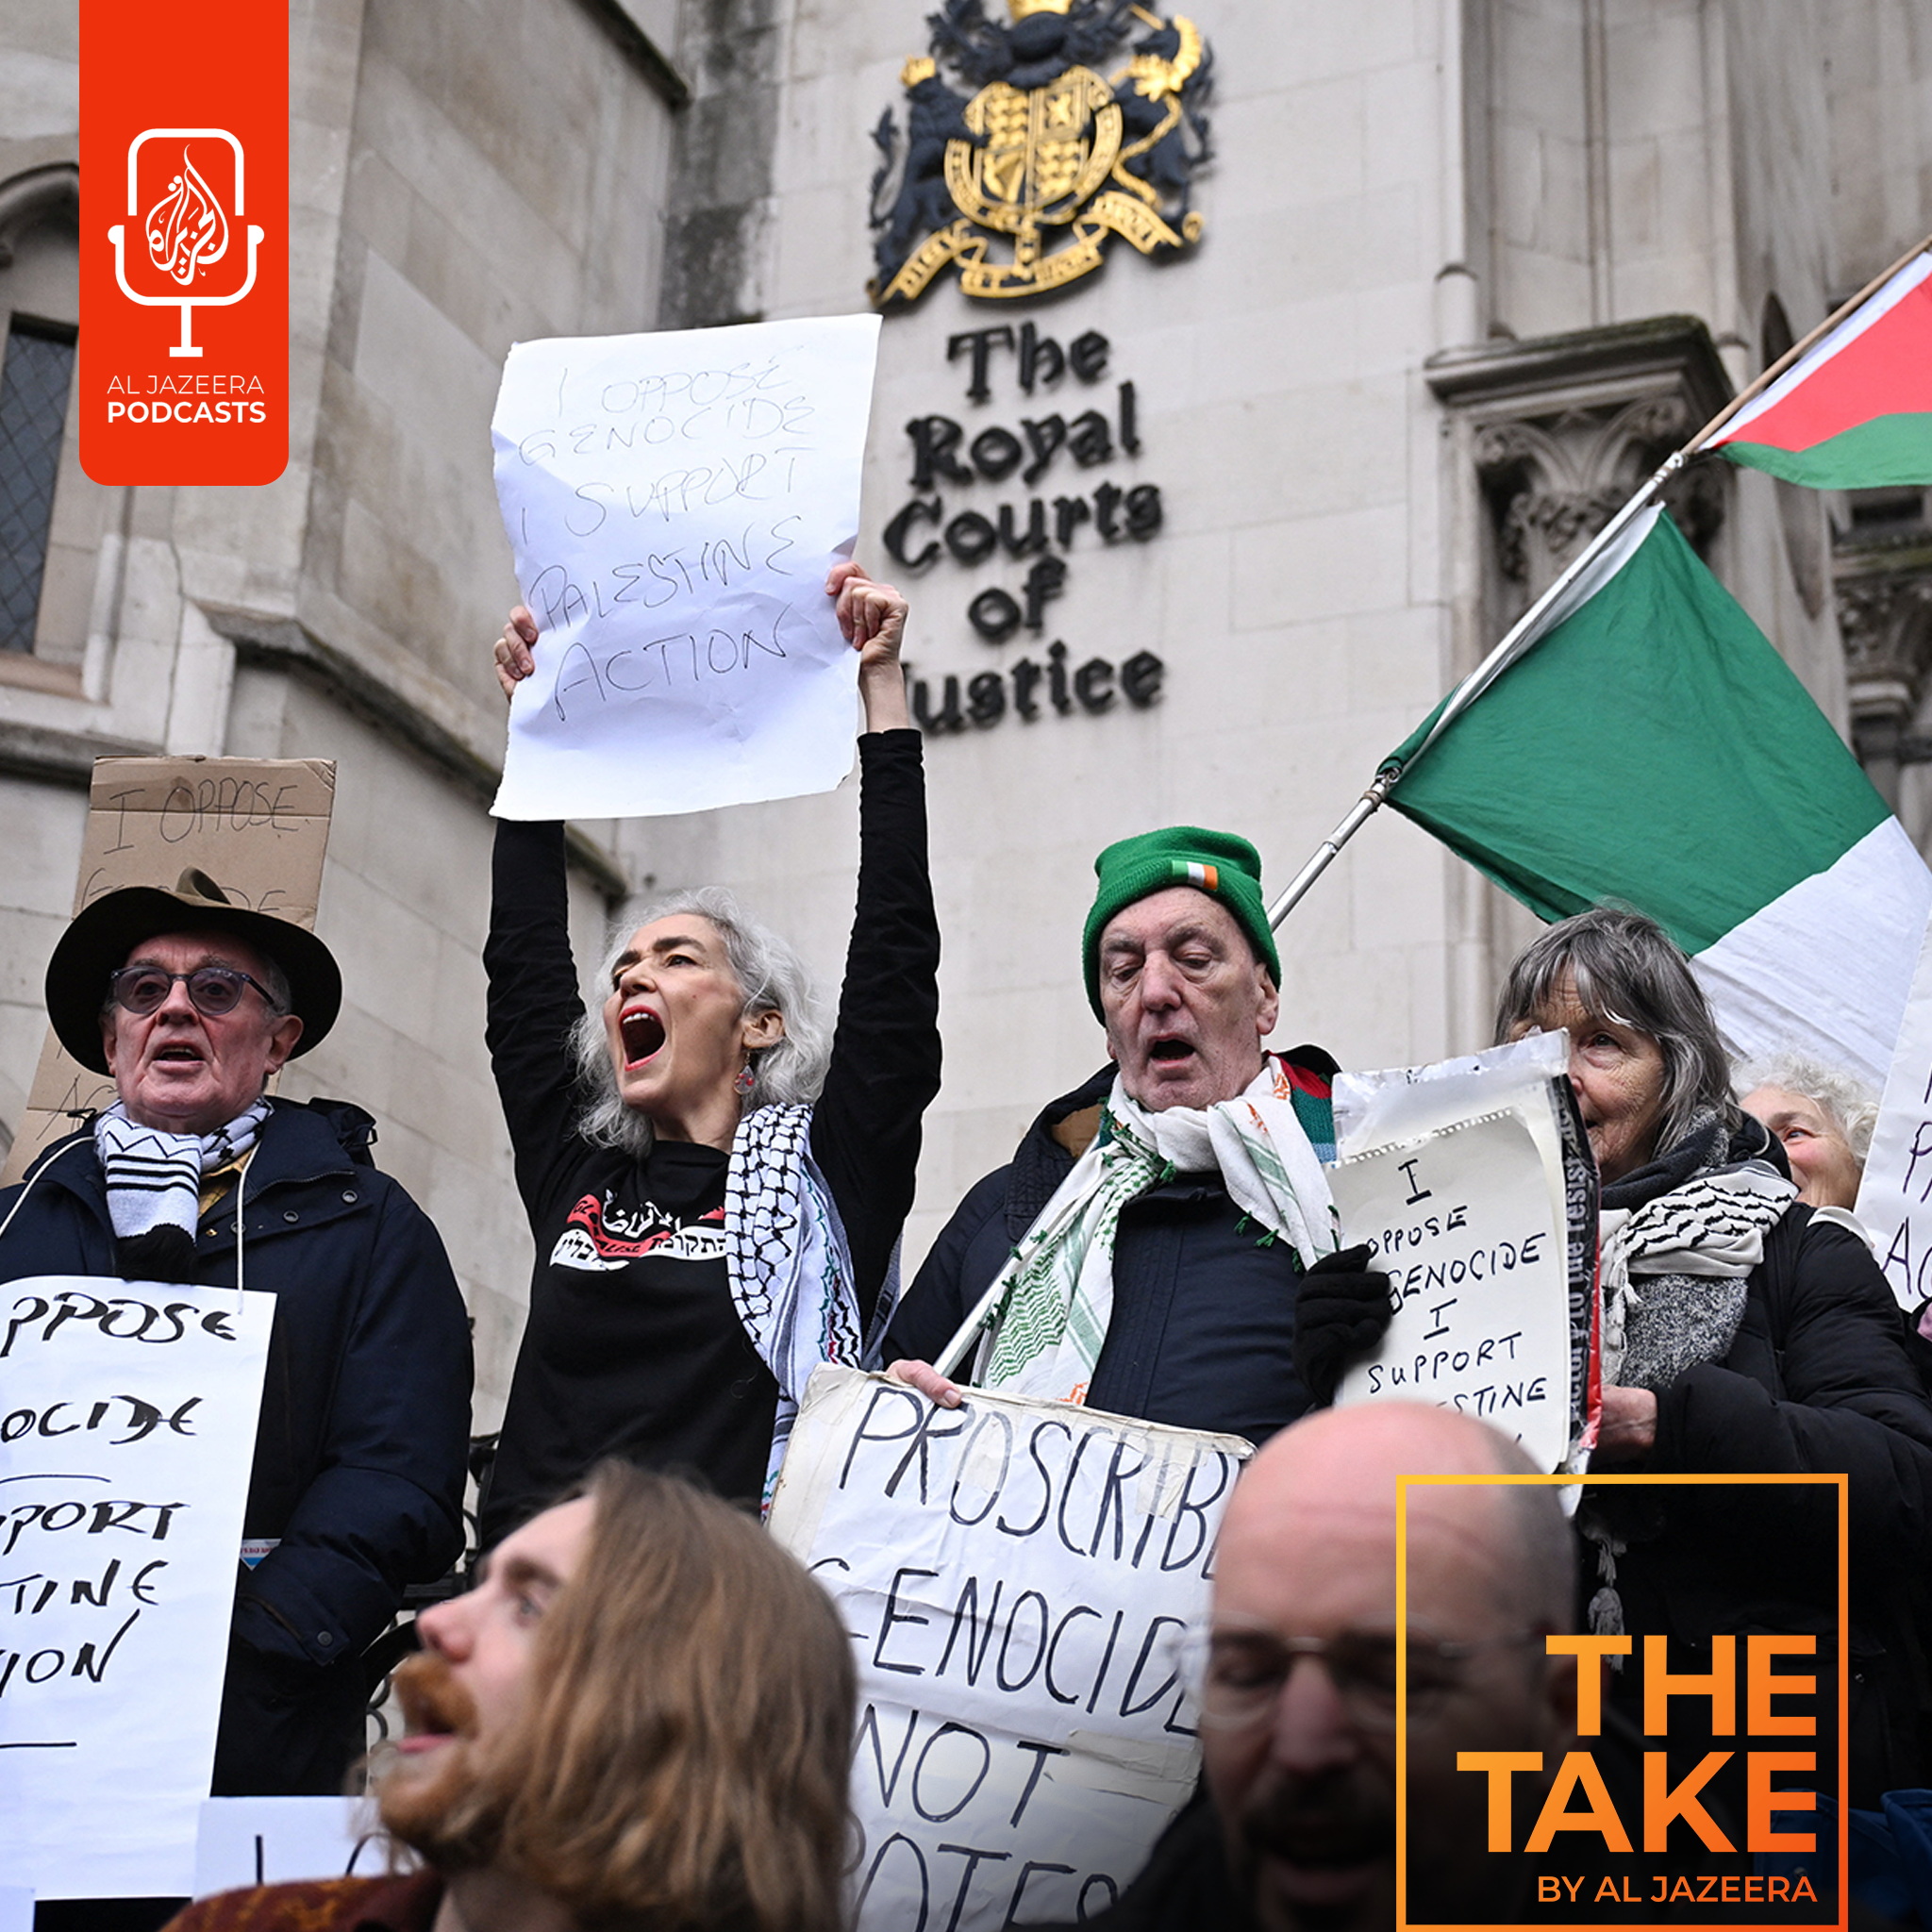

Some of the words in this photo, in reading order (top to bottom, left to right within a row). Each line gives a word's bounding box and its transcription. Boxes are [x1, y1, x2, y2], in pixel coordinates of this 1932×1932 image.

[604, 349, 800, 414] OPPOSE
[947, 320, 1109, 405] The
[519, 396, 815, 466] GENOCIDE
[905, 379, 1141, 490] Royal
[565, 446, 816, 537] SUPPORT
[883, 480, 1163, 567] Courts
[528, 515, 802, 628] PALESTINE
[967, 554, 1068, 643] of
[554, 604, 792, 722] ACTION
[900, 640, 1163, 734] ustice
[104, 789, 145, 854] I
[159, 776, 299, 843] OPPOSE
[1397, 1158, 1432, 1206] I
[1368, 1206, 1468, 1259] OPPOSE
[1388, 1232, 1546, 1316] GENOCIDE
[1424, 1299, 1457, 1341] I
[0, 1394, 203, 1444] OCIDE
[1436, 1377, 1547, 1417] STINE
[840, 1386, 1227, 1581] PROSCRIB
[0, 1501, 191, 1556] PORT
[0, 1607, 141, 1699] ION
[808, 1557, 1197, 1737] ENOCID
[852, 1704, 1071, 1828] NOT
